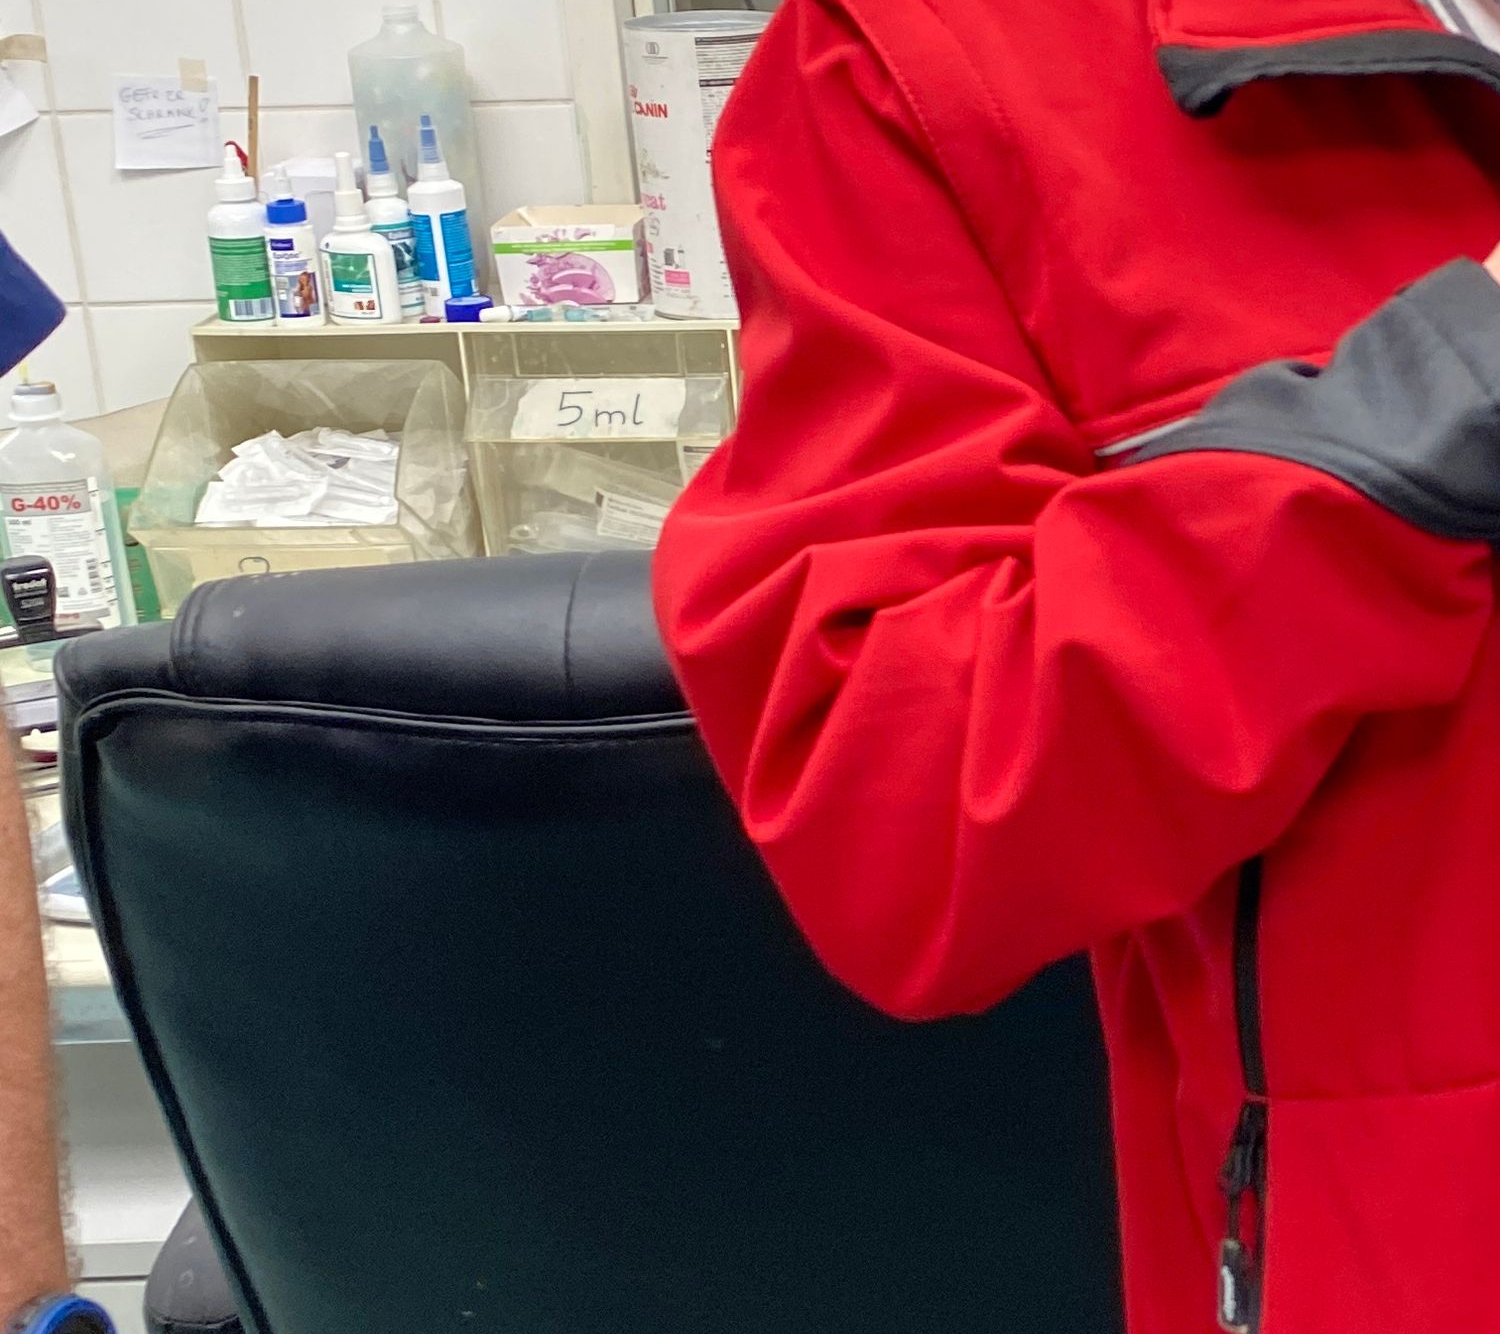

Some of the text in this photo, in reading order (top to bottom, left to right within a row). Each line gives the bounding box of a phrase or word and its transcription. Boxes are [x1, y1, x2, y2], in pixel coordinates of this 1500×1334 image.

[556, 389, 644, 428] 5 ml
[11, 494, 81, 513] G-40%
